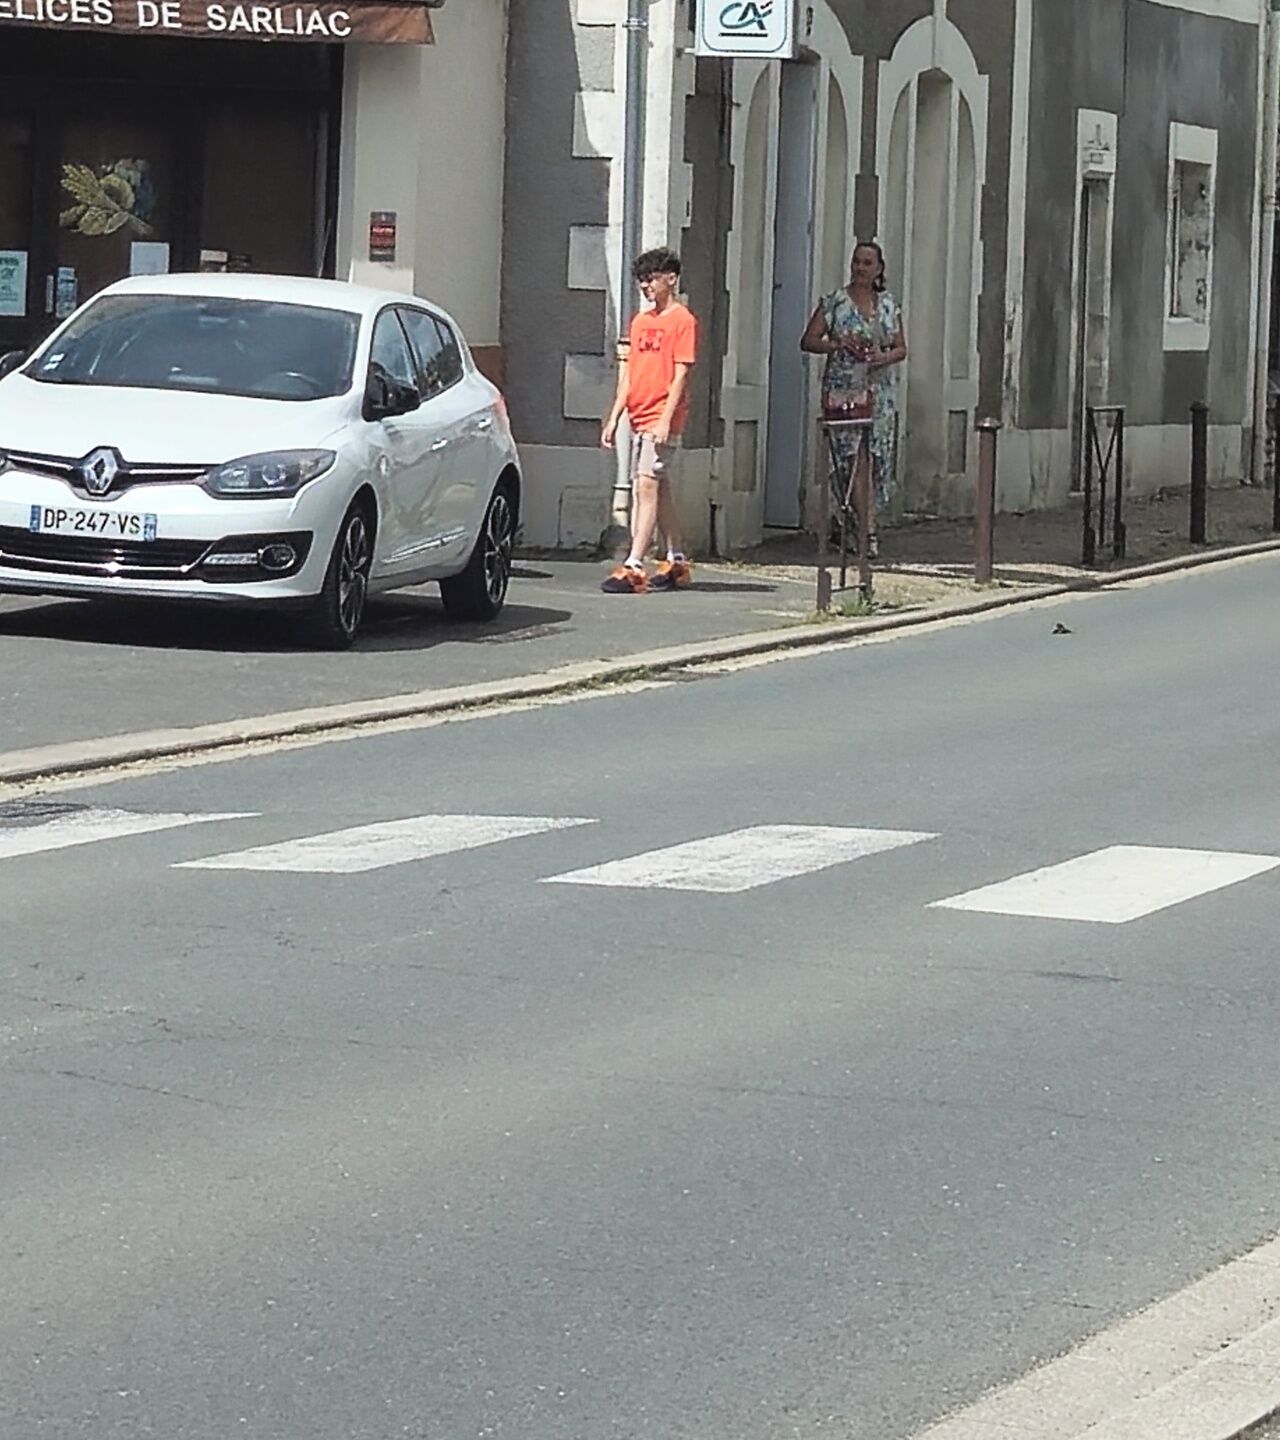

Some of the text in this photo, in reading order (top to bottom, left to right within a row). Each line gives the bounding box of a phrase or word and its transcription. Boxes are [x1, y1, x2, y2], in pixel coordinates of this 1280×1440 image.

[137, 0, 183, 29] DE
[206, 3, 352, 37] SARLIAC
[43, 508, 141, 535] DP-247-VS
